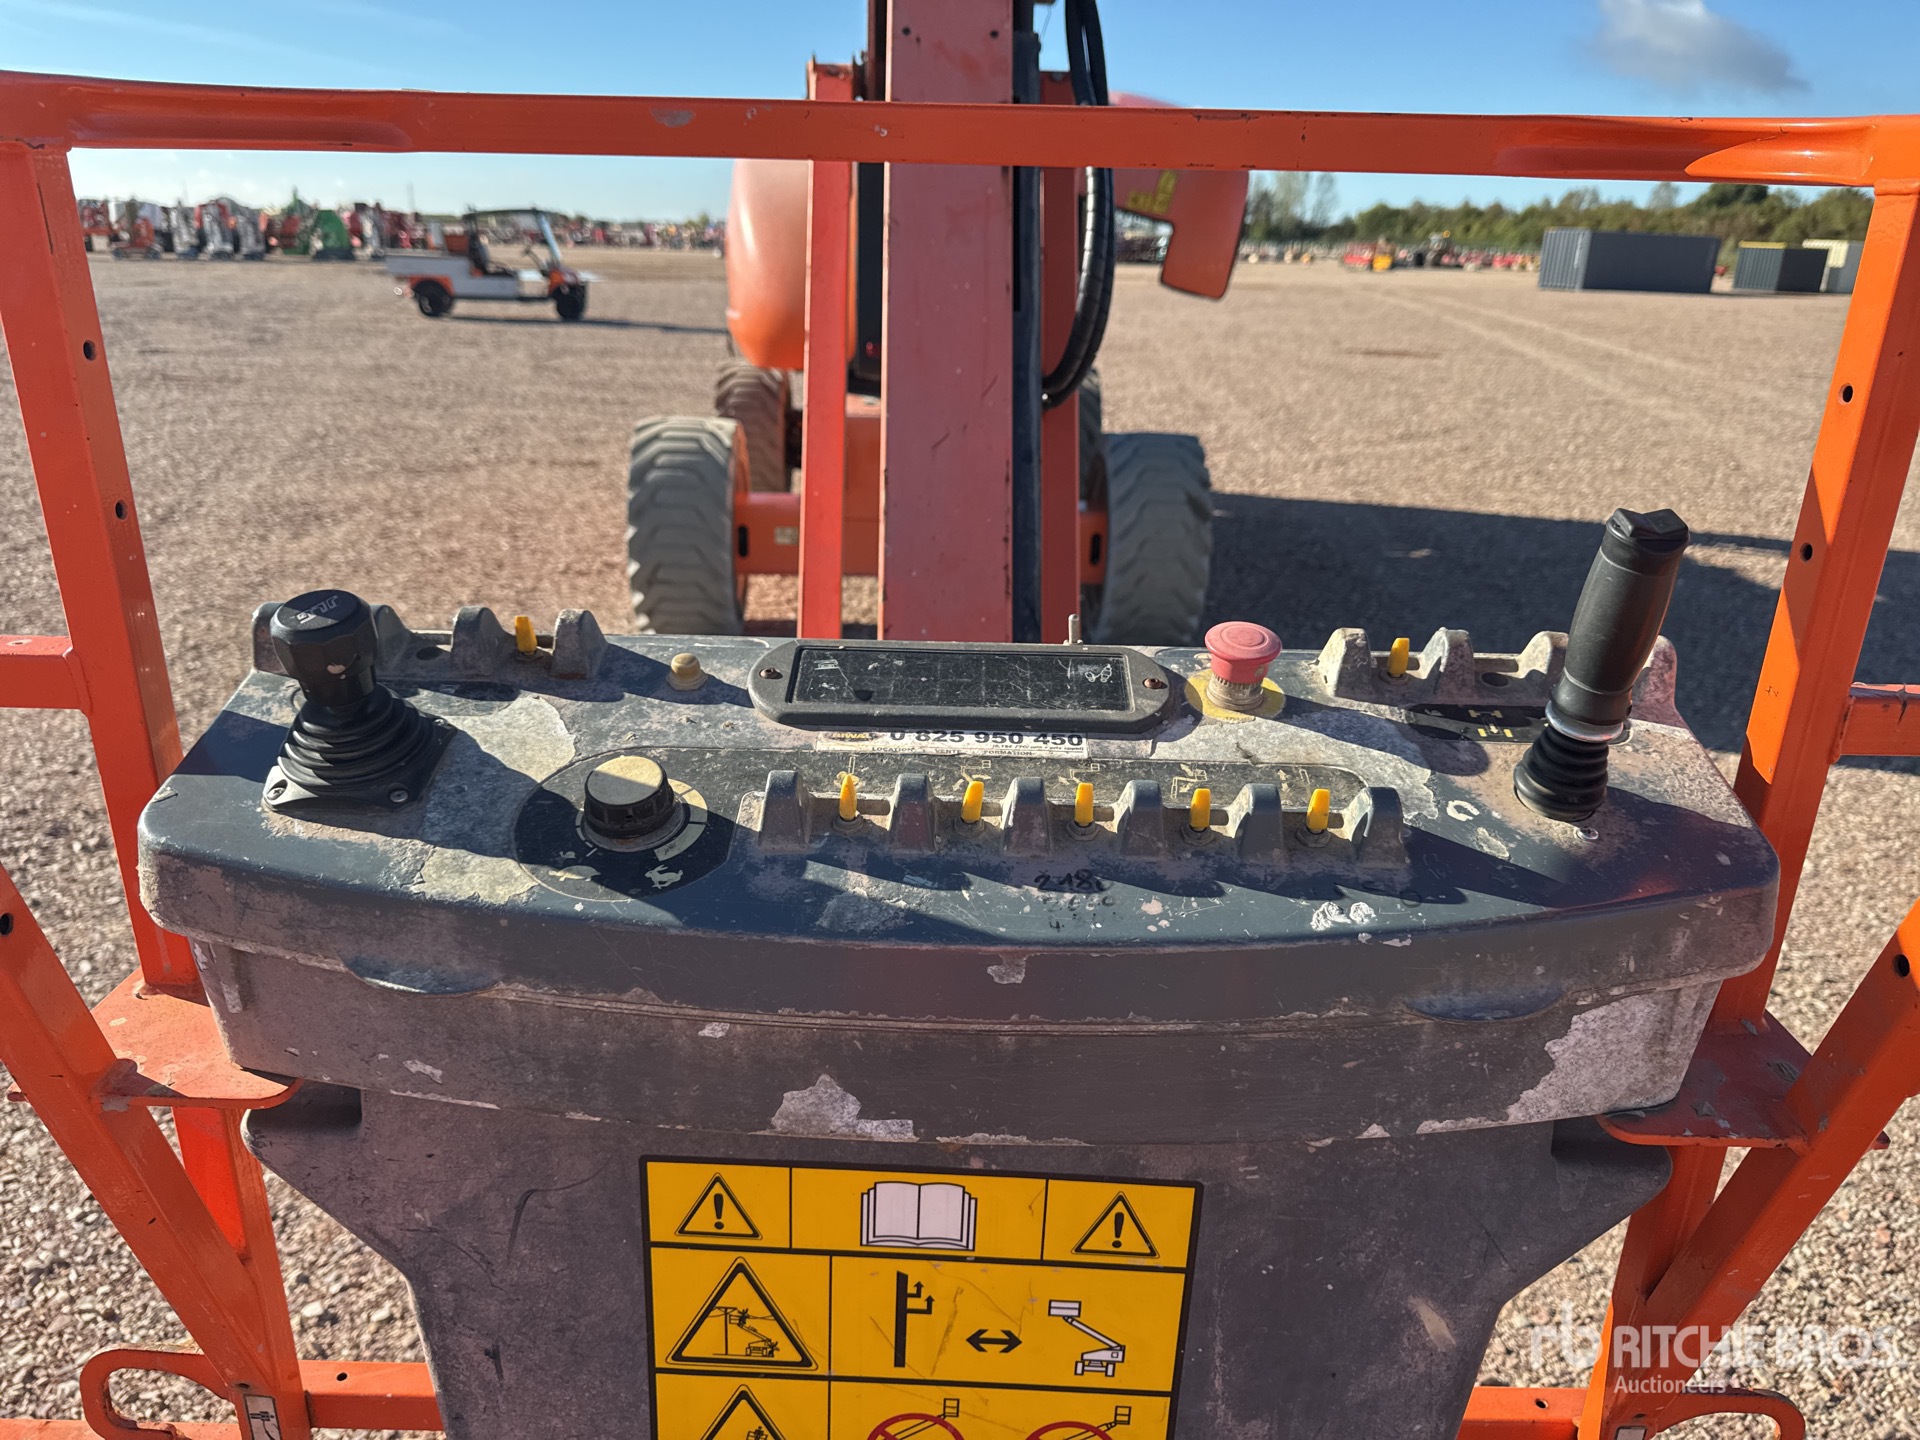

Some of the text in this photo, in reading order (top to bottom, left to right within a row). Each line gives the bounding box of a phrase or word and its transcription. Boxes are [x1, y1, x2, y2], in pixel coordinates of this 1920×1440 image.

[889, 731, 905, 741] 0
[915, 730, 964, 743] 825
[974, 731, 1023, 744] 950
[1033, 732, 1083, 746] 450
